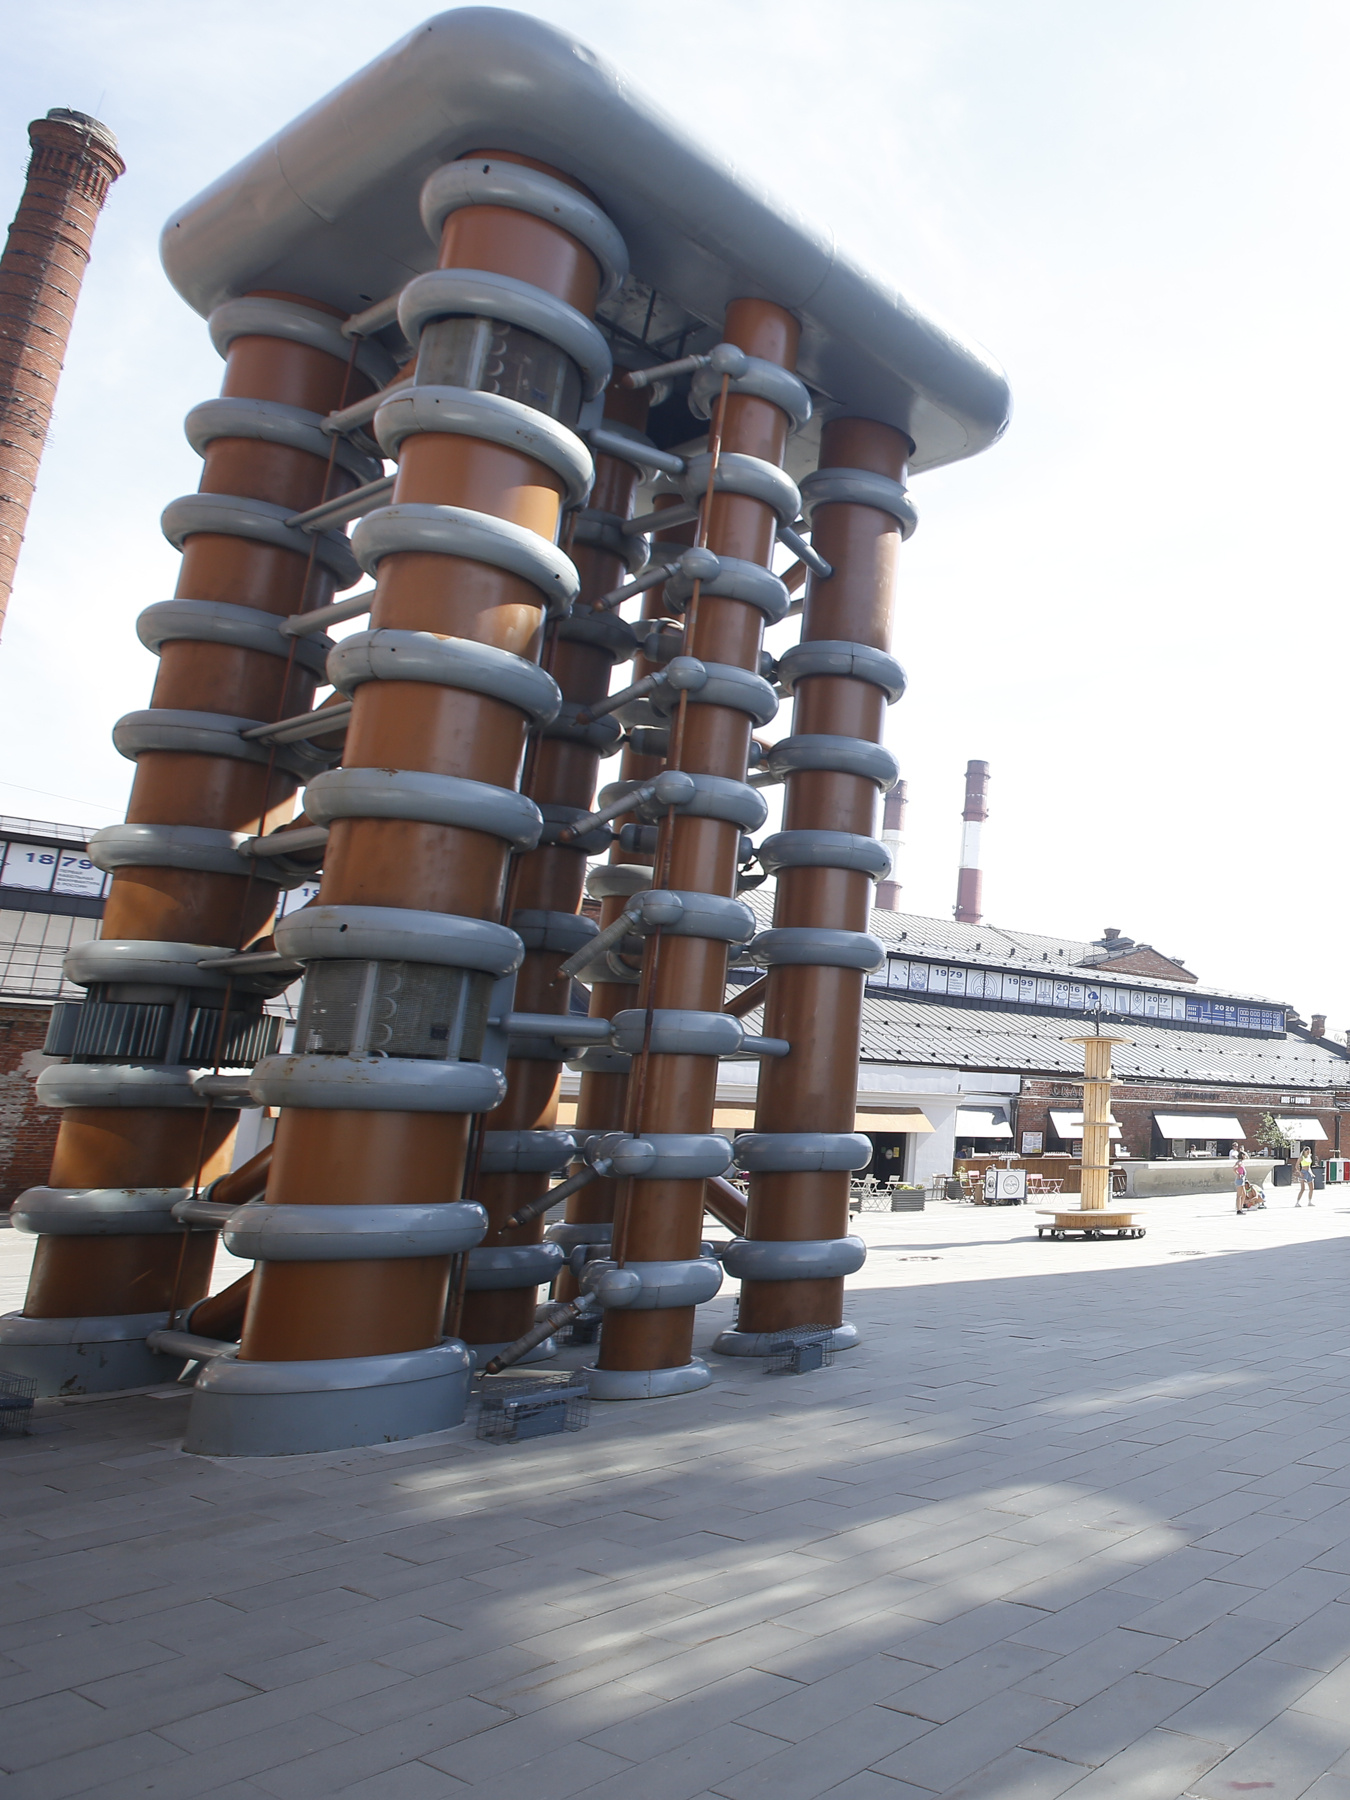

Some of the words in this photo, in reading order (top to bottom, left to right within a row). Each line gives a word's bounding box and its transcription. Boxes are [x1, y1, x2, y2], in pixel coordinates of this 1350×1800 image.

[26, 853, 93, 870] 1879
[935, 969, 963, 978] 1979
[1008, 978, 1034, 987] 1999
[1057, 984, 1080, 993] 2016
[1147, 996, 1168, 1004] 2017
[1214, 1004, 1235, 1012] 2020
